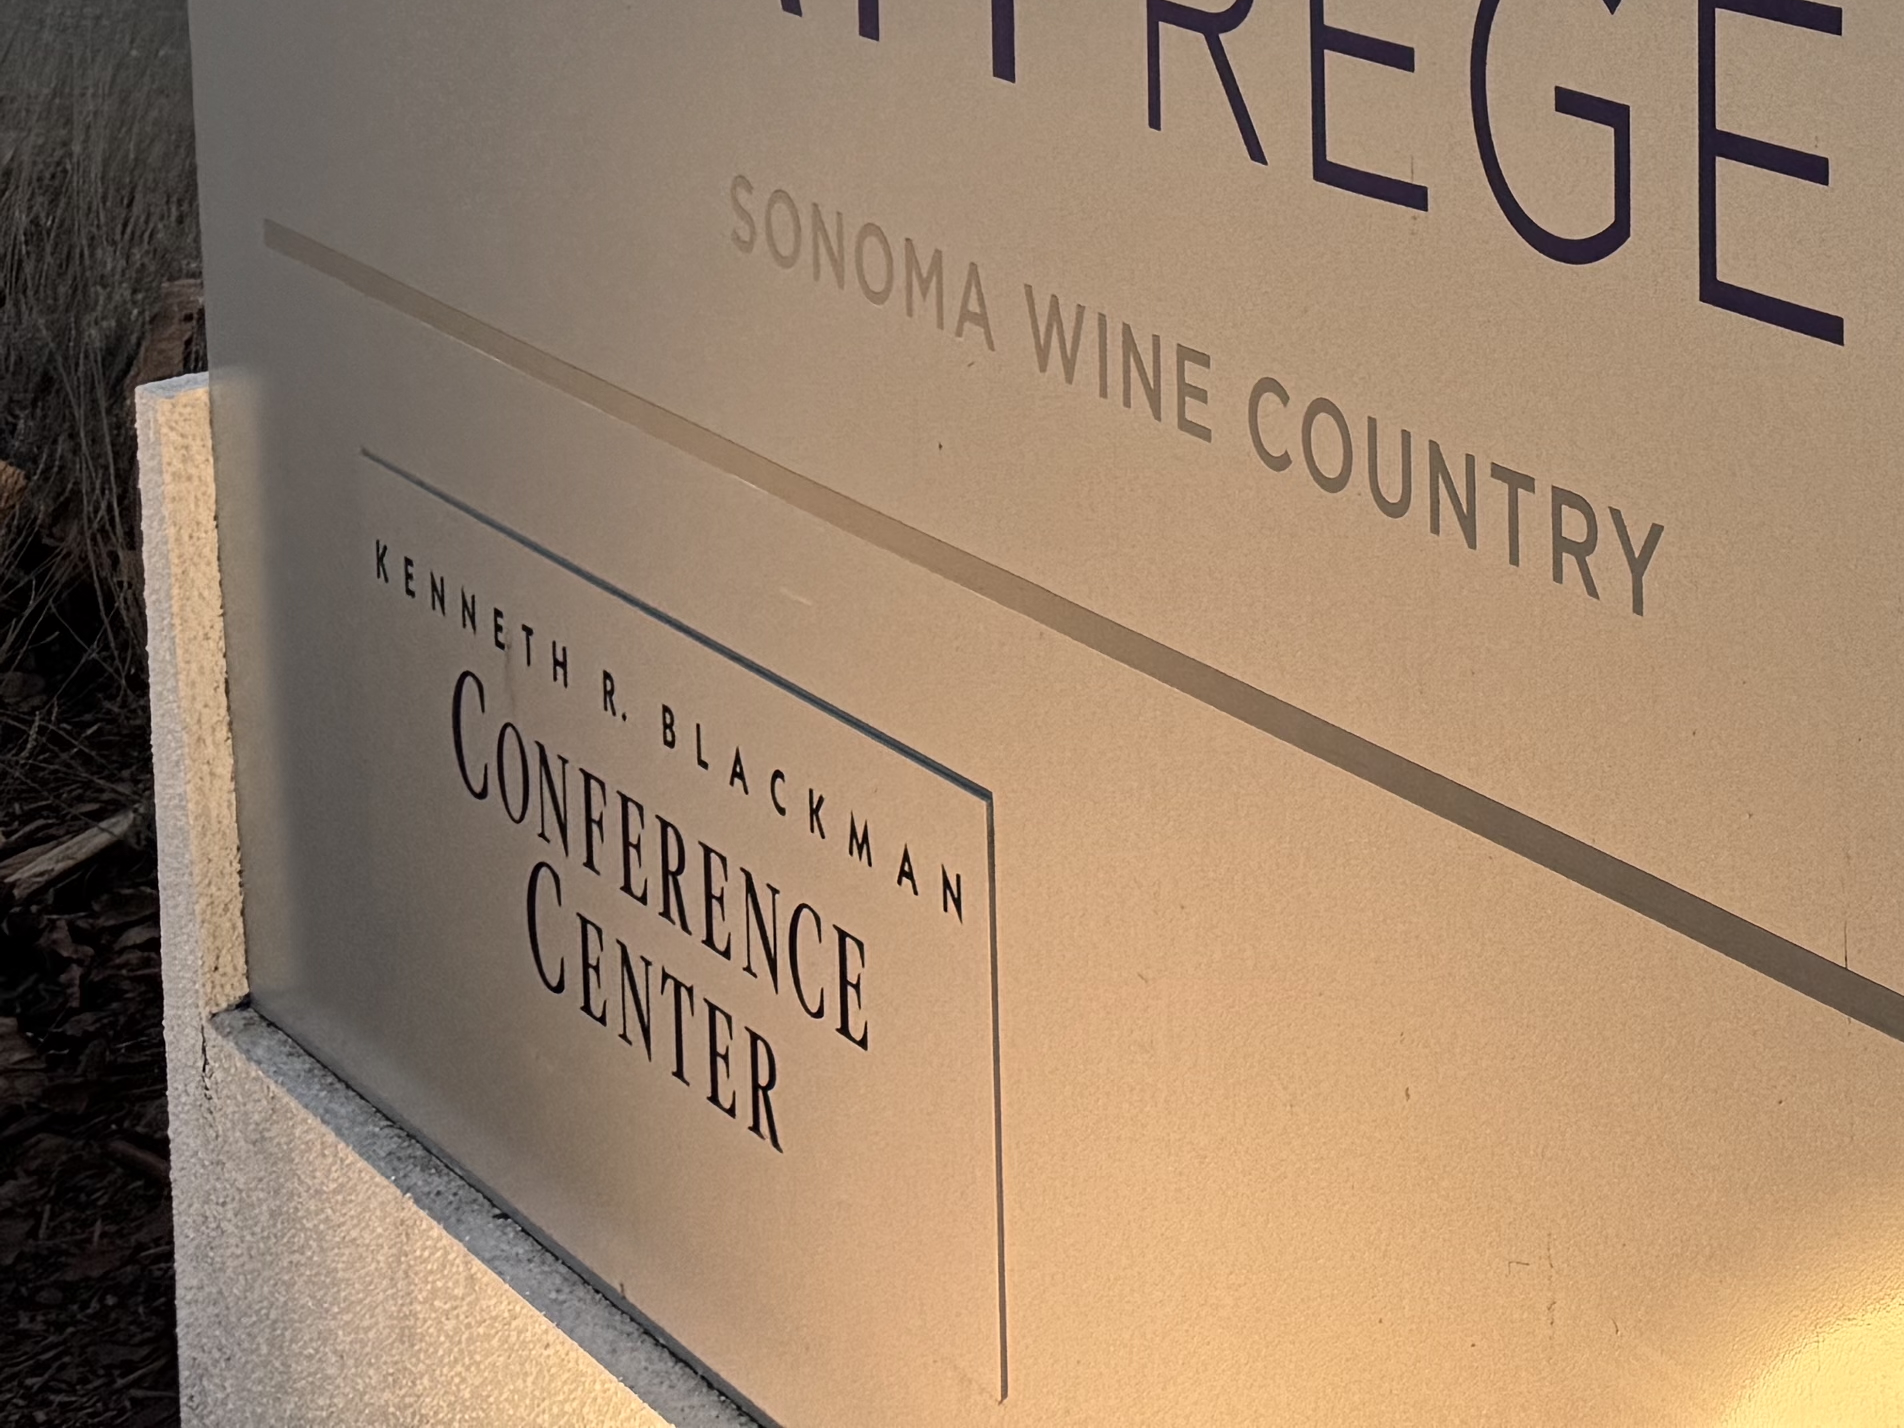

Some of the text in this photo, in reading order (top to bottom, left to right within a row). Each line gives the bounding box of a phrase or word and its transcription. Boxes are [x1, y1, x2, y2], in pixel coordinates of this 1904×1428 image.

[730, 175, 1665, 617] SONOMA WINE COUNTRY
[375, 540, 964, 924] KENNETH R. BLACKMAN
[451, 670, 869, 1052] CONFERENCE
[526, 860, 784, 1154] CENTER
